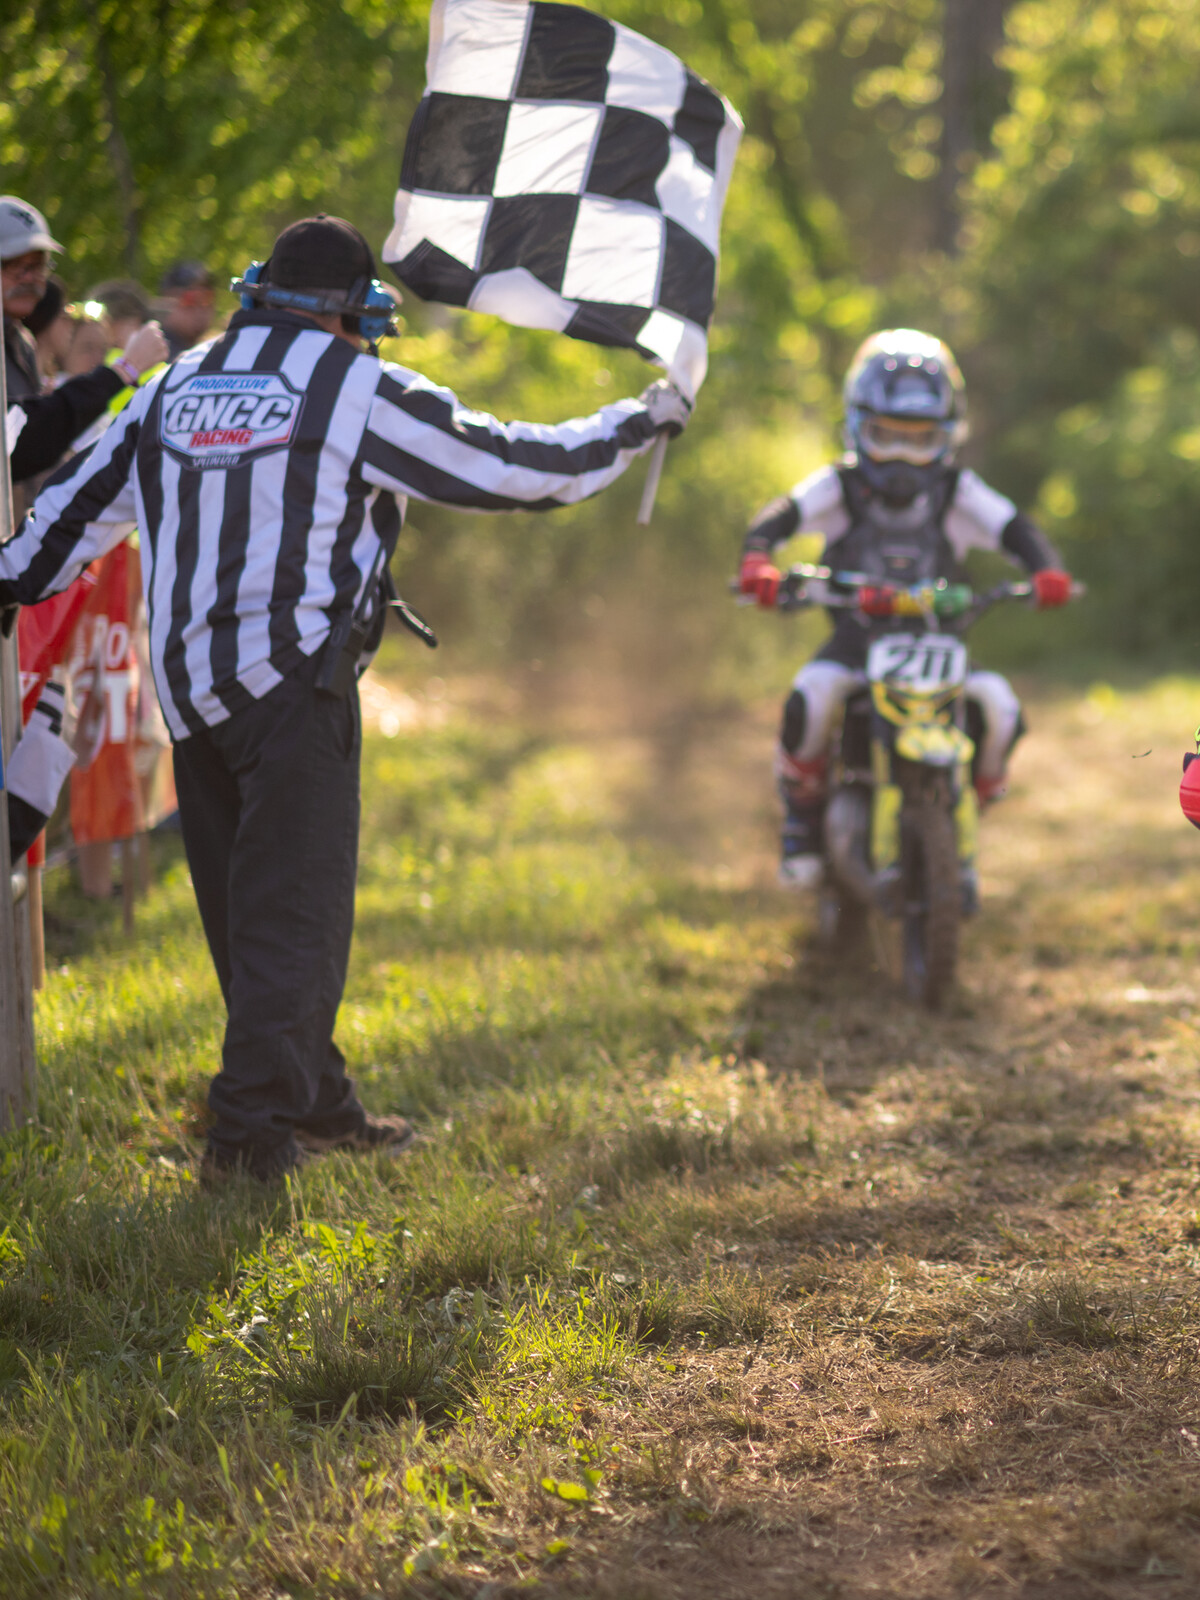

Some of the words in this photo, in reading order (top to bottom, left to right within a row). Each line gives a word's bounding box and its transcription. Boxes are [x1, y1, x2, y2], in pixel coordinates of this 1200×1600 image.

[188, 378, 271, 391] PROGRESSIVE
[165, 393, 294, 434] GNCC
[189, 429, 254, 449] RACING
